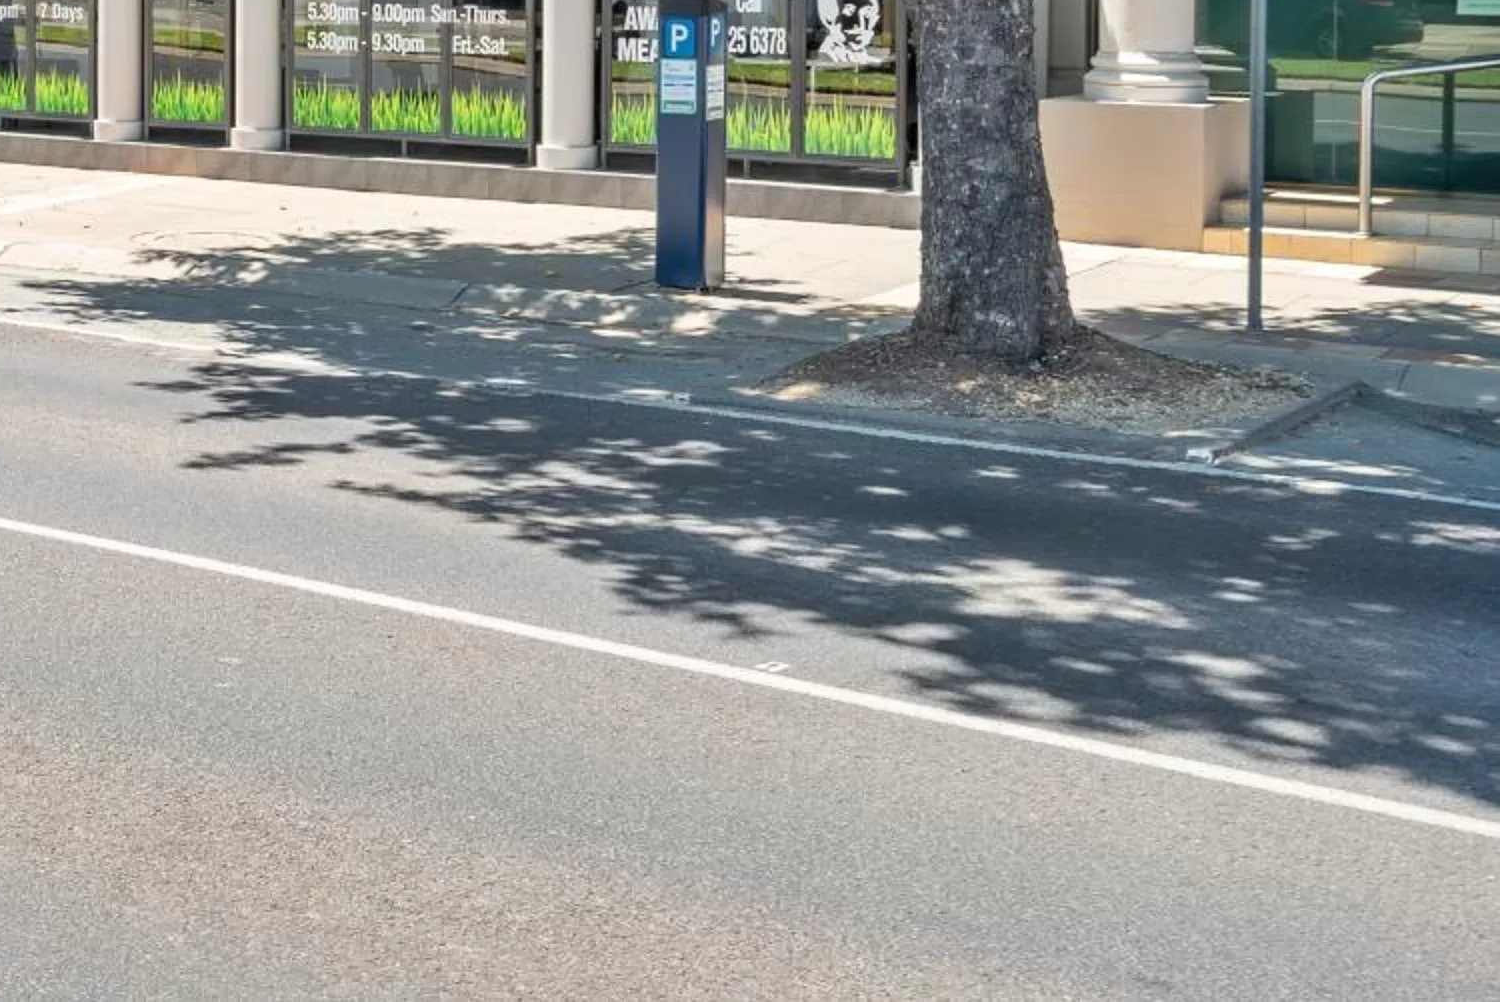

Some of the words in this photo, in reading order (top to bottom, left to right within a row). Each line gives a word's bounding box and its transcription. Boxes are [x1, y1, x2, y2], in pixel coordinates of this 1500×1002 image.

[53, 3, 84, 22] Days
[308, 1, 359, 25] 5.30pm
[372, 3, 425, 26] 9.00pm
[624, 6, 658, 31] AW
[307, 31, 359, 54] 5.30pm
[372, 33, 425, 55] 9.30pm
[671, 23, 689, 53] P
[710, 18, 721, 47] P
[727, 26, 747, 54] 25
[750, 26, 787, 55] 6378
[617, 37, 659, 63] MEA
